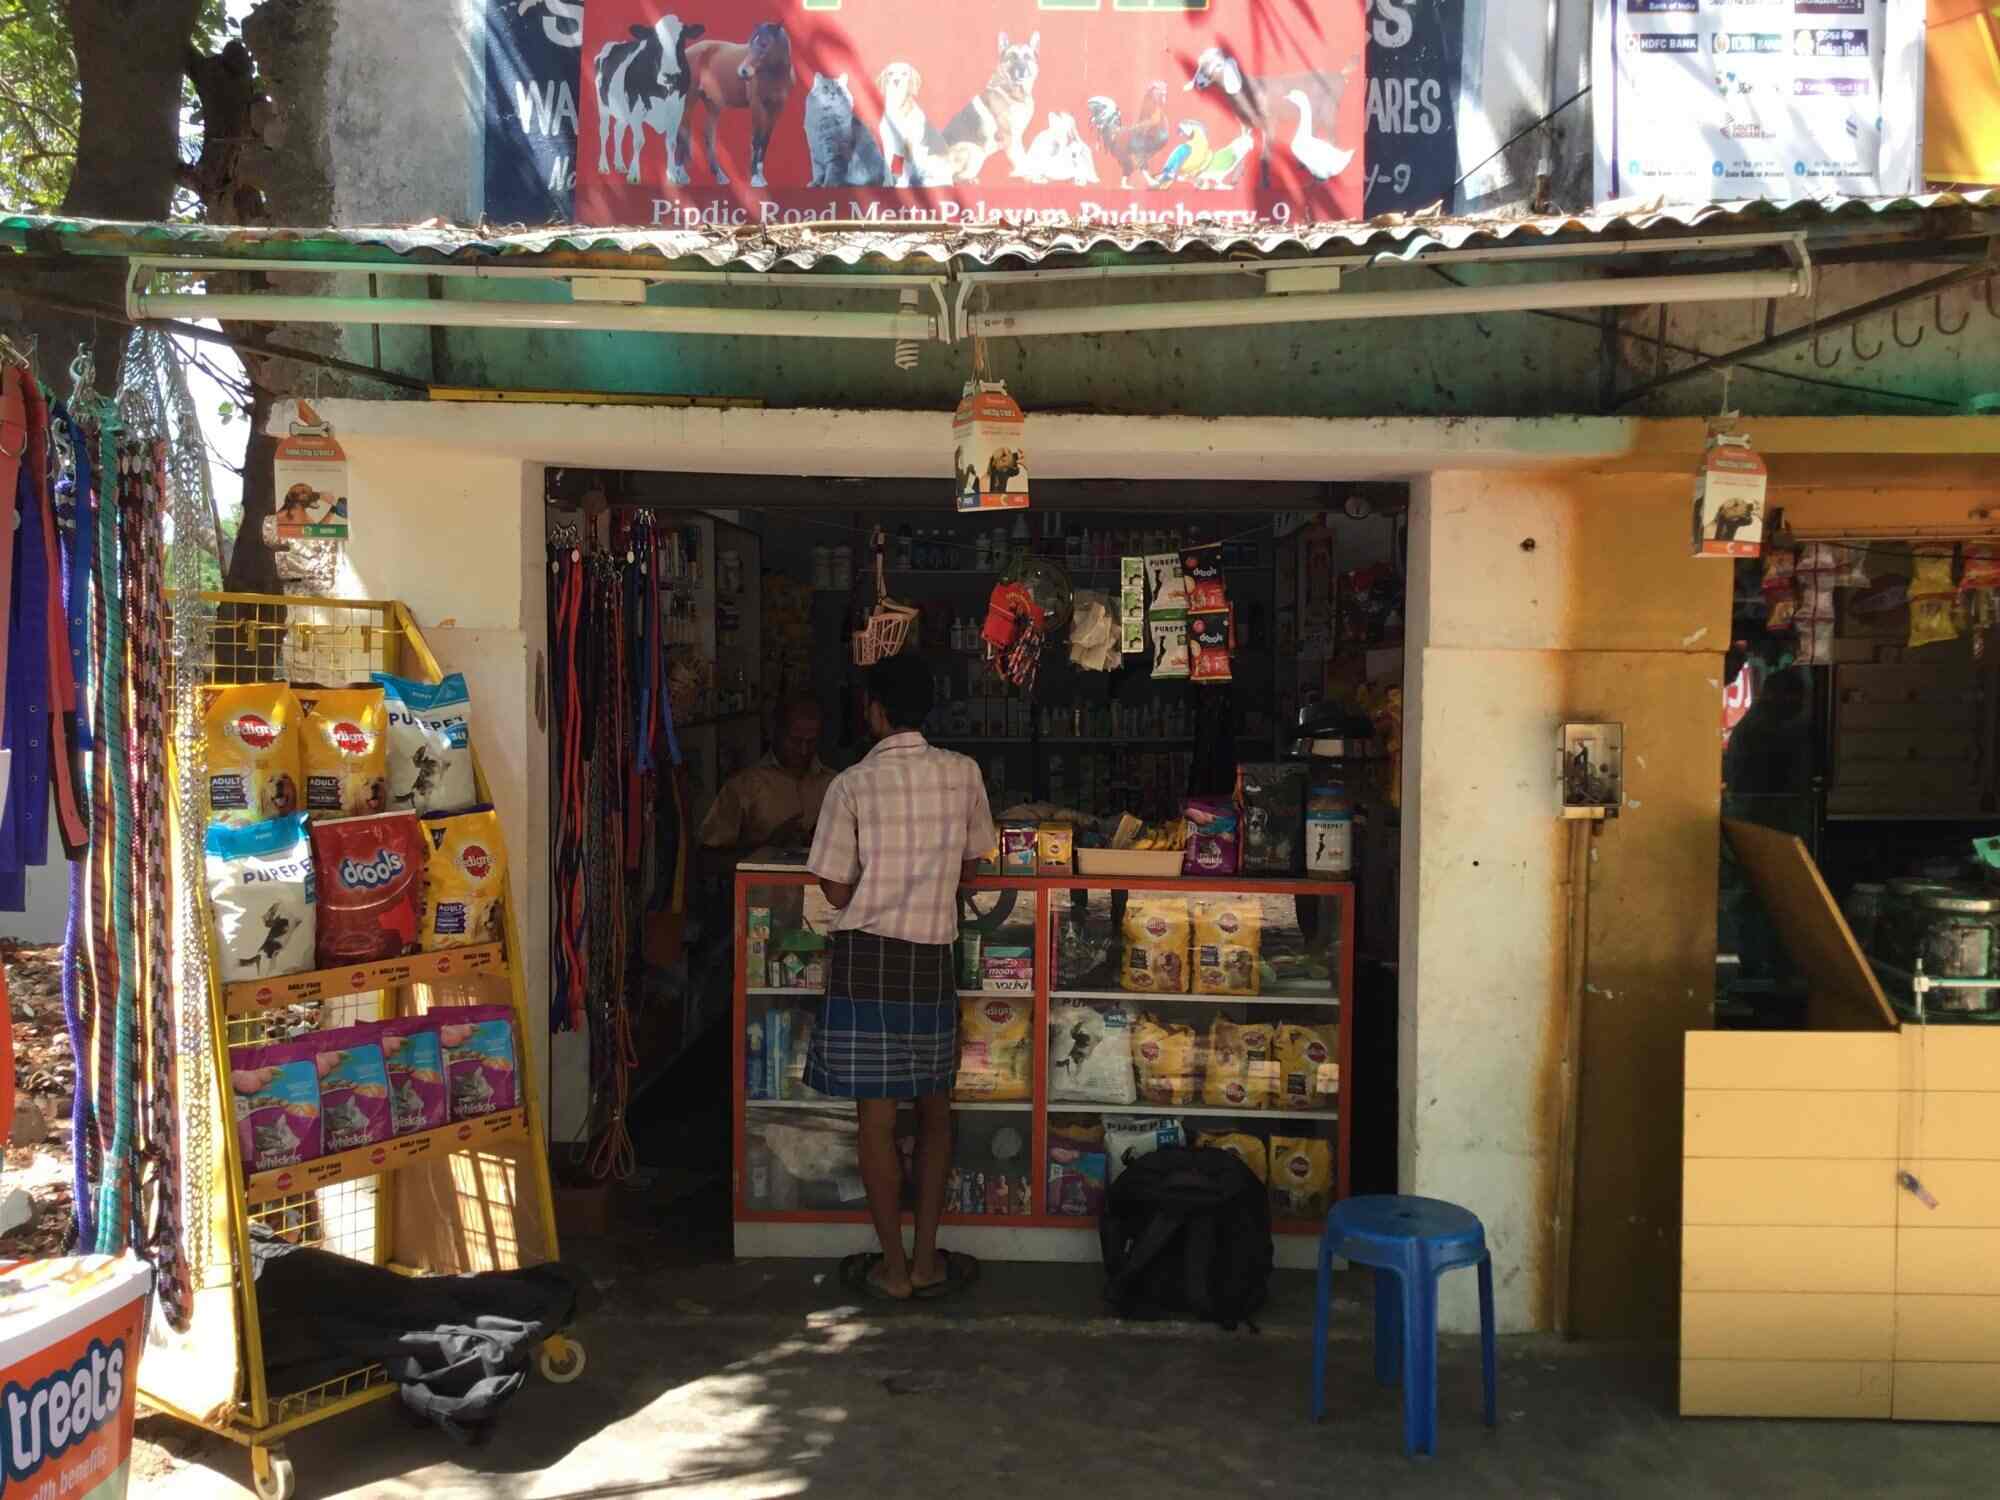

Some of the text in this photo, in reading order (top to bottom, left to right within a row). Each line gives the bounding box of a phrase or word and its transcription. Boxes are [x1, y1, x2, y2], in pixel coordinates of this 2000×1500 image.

[1641, 37, 1697, 49] HDFC BANK
[1366, 78, 1441, 134] ARES
[651, 199, 747, 229] Pipdic
[759, 201, 837, 225] Road
[211, 777, 241, 785] ADULT
[309, 778, 337, 786] ADULT
[343, 851, 402, 884] drools
[8, 1348, 124, 1470] treats
